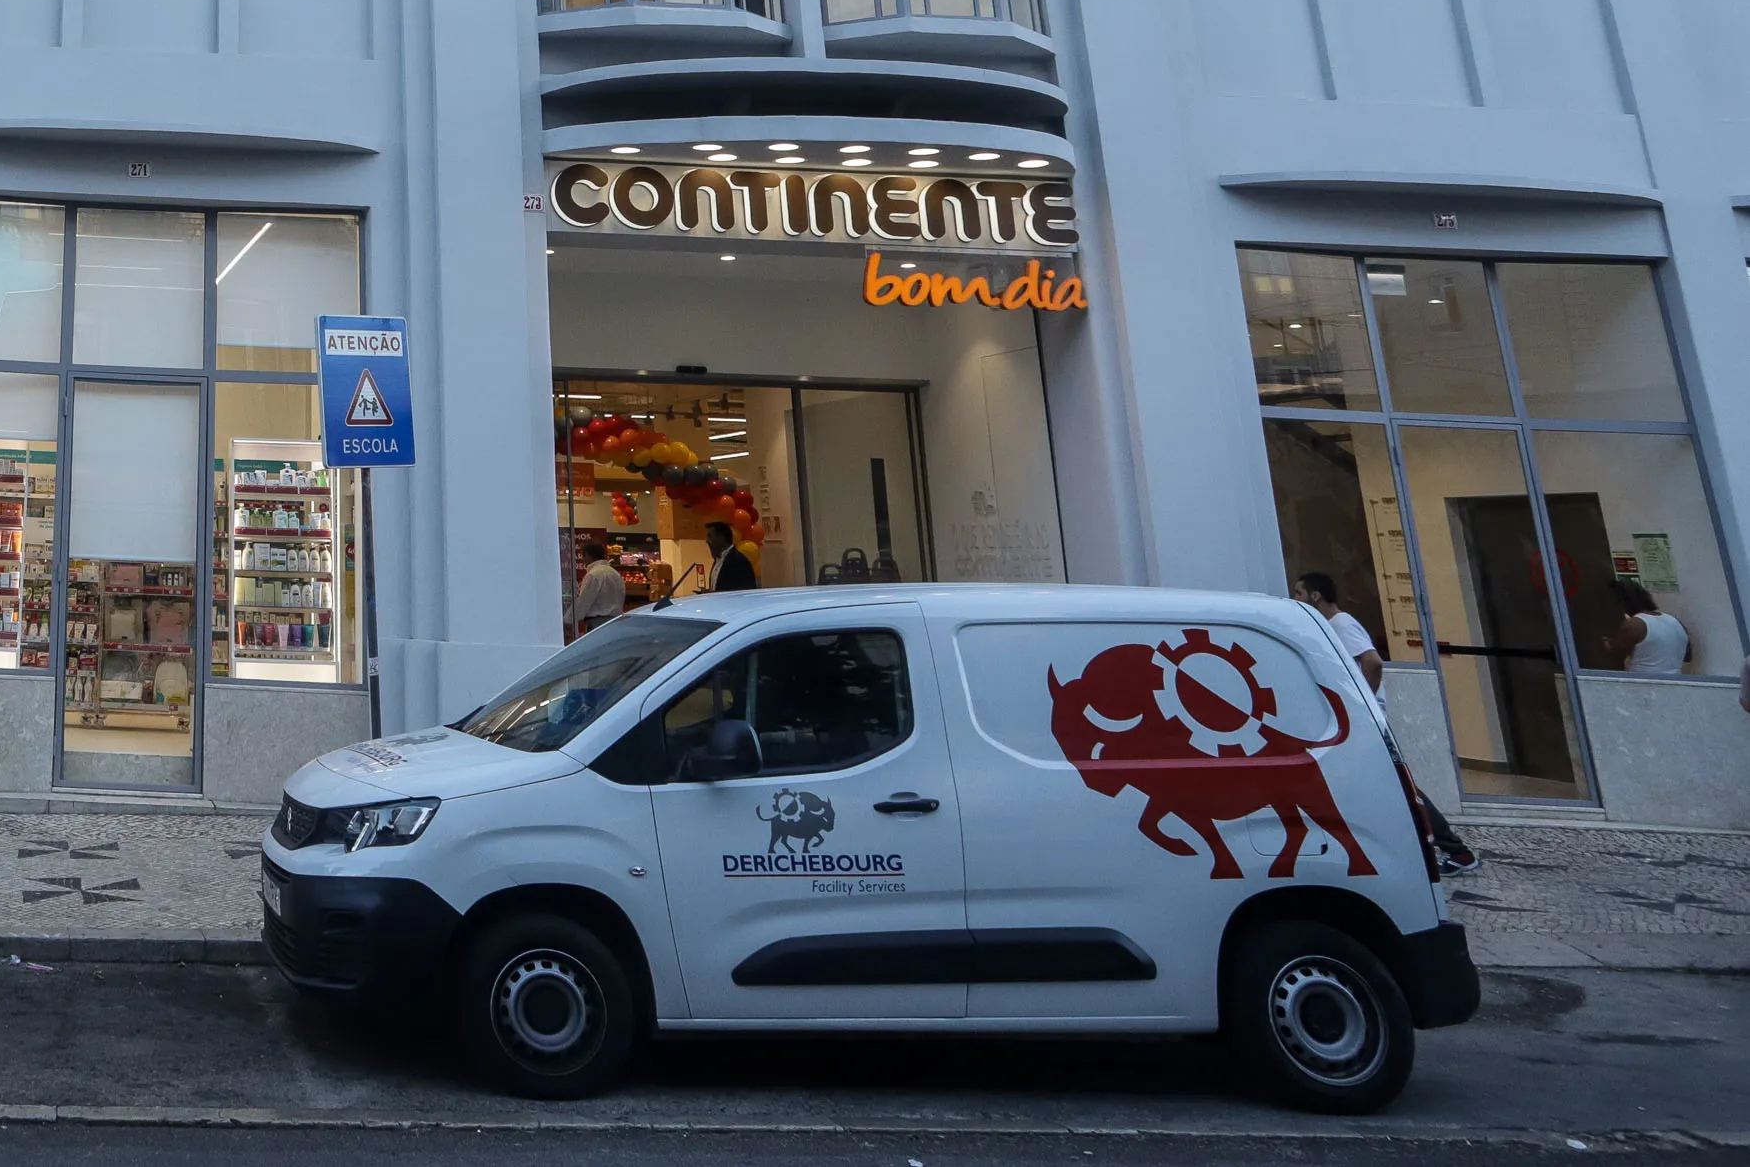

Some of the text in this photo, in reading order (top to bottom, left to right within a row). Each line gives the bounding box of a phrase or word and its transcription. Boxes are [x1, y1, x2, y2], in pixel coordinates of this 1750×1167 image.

[131, 163, 148, 176] 271
[523, 195, 542, 210] 273
[551, 164, 1080, 246] CONTINENTE
[862, 252, 1088, 311] bom dia
[327, 333, 401, 355] ATENÇÃO
[342, 438, 399, 454] ESCOLA
[722, 854, 903, 872] DERICHEBOURG
[812, 879, 906, 896] Facility Services
